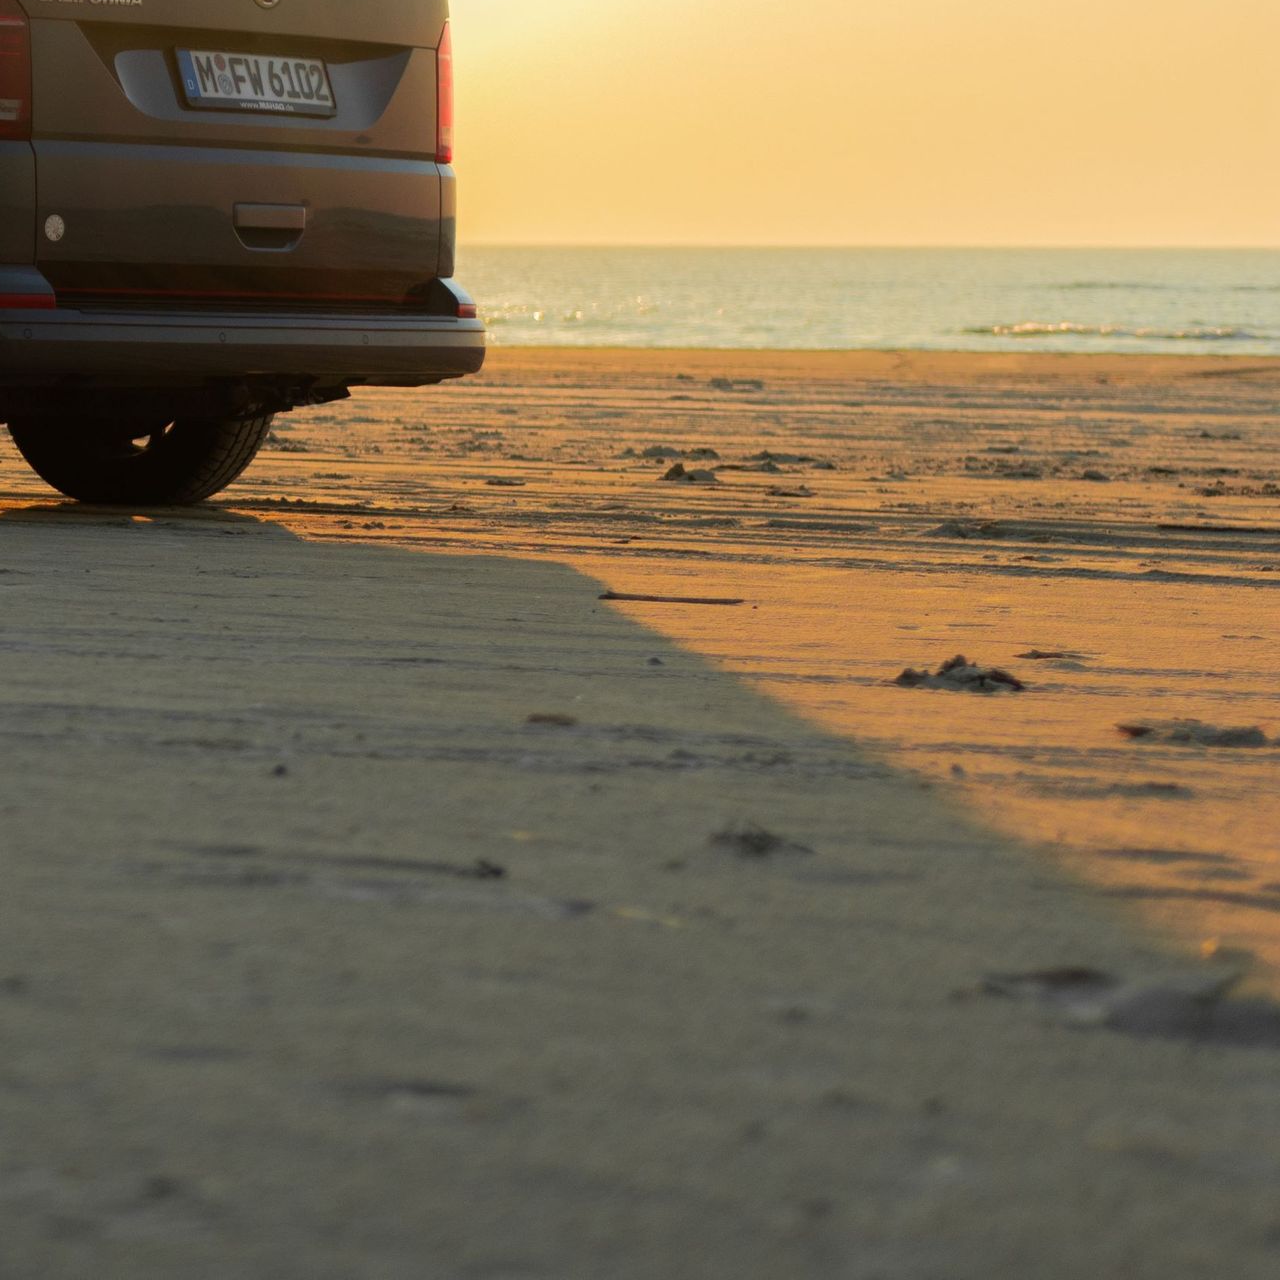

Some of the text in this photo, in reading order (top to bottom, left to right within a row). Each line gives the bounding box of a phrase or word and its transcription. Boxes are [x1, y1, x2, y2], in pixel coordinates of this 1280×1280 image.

[195, 55, 329, 101] M FW 6102
